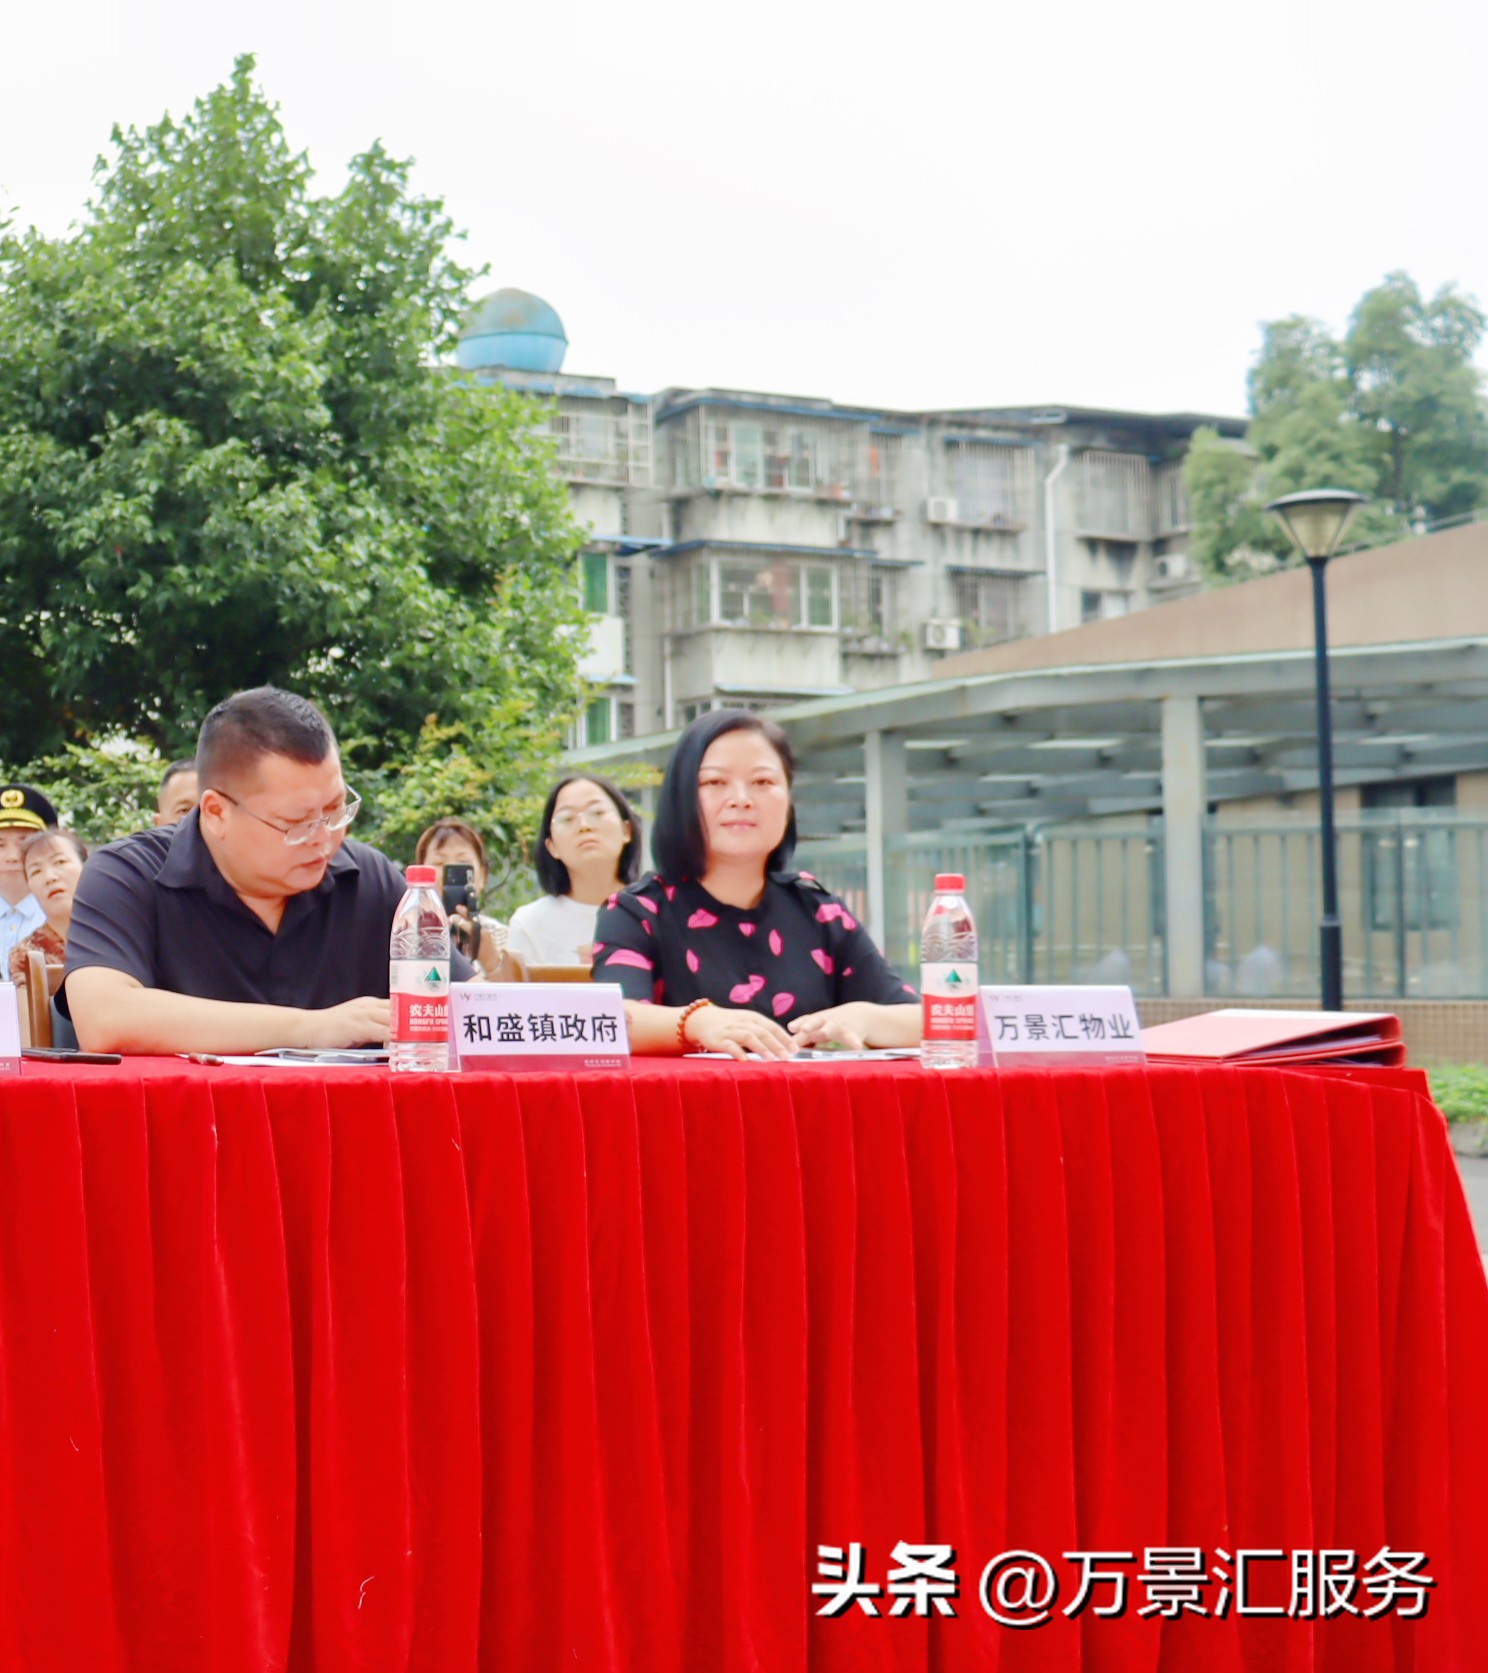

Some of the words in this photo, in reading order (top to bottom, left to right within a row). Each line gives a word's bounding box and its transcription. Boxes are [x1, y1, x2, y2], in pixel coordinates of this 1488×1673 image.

[463, 1013, 618, 1043] 和盛镇政府
[994, 1013, 1134, 1041] 万景汇物业
